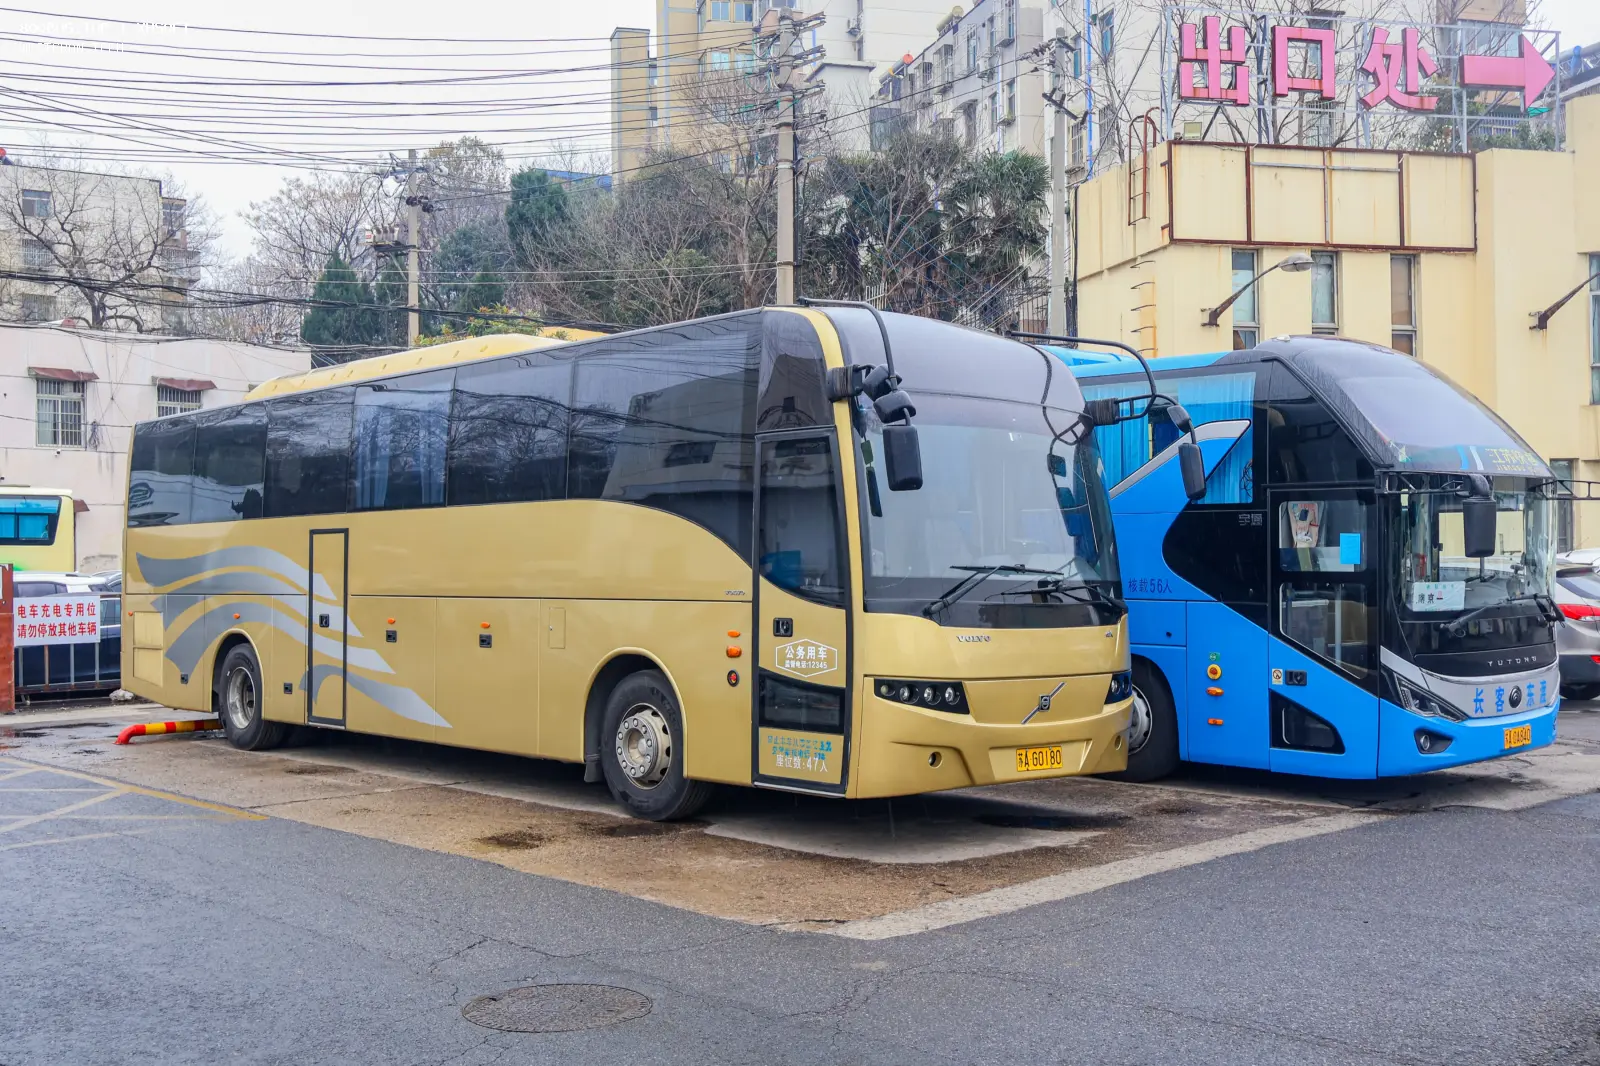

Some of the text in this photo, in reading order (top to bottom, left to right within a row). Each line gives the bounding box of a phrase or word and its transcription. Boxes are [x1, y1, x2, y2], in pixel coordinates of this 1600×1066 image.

[1179, 16, 1439, 112] 出口处
[1127, 577, 1173, 594] 核载56人
[17, 602, 97, 619] 电车充电专用位
[17, 621, 97, 639] 请勿停放其他车辆
[956, 634, 992, 643] VOLVO
[784, 644, 828, 660] 公务用车
